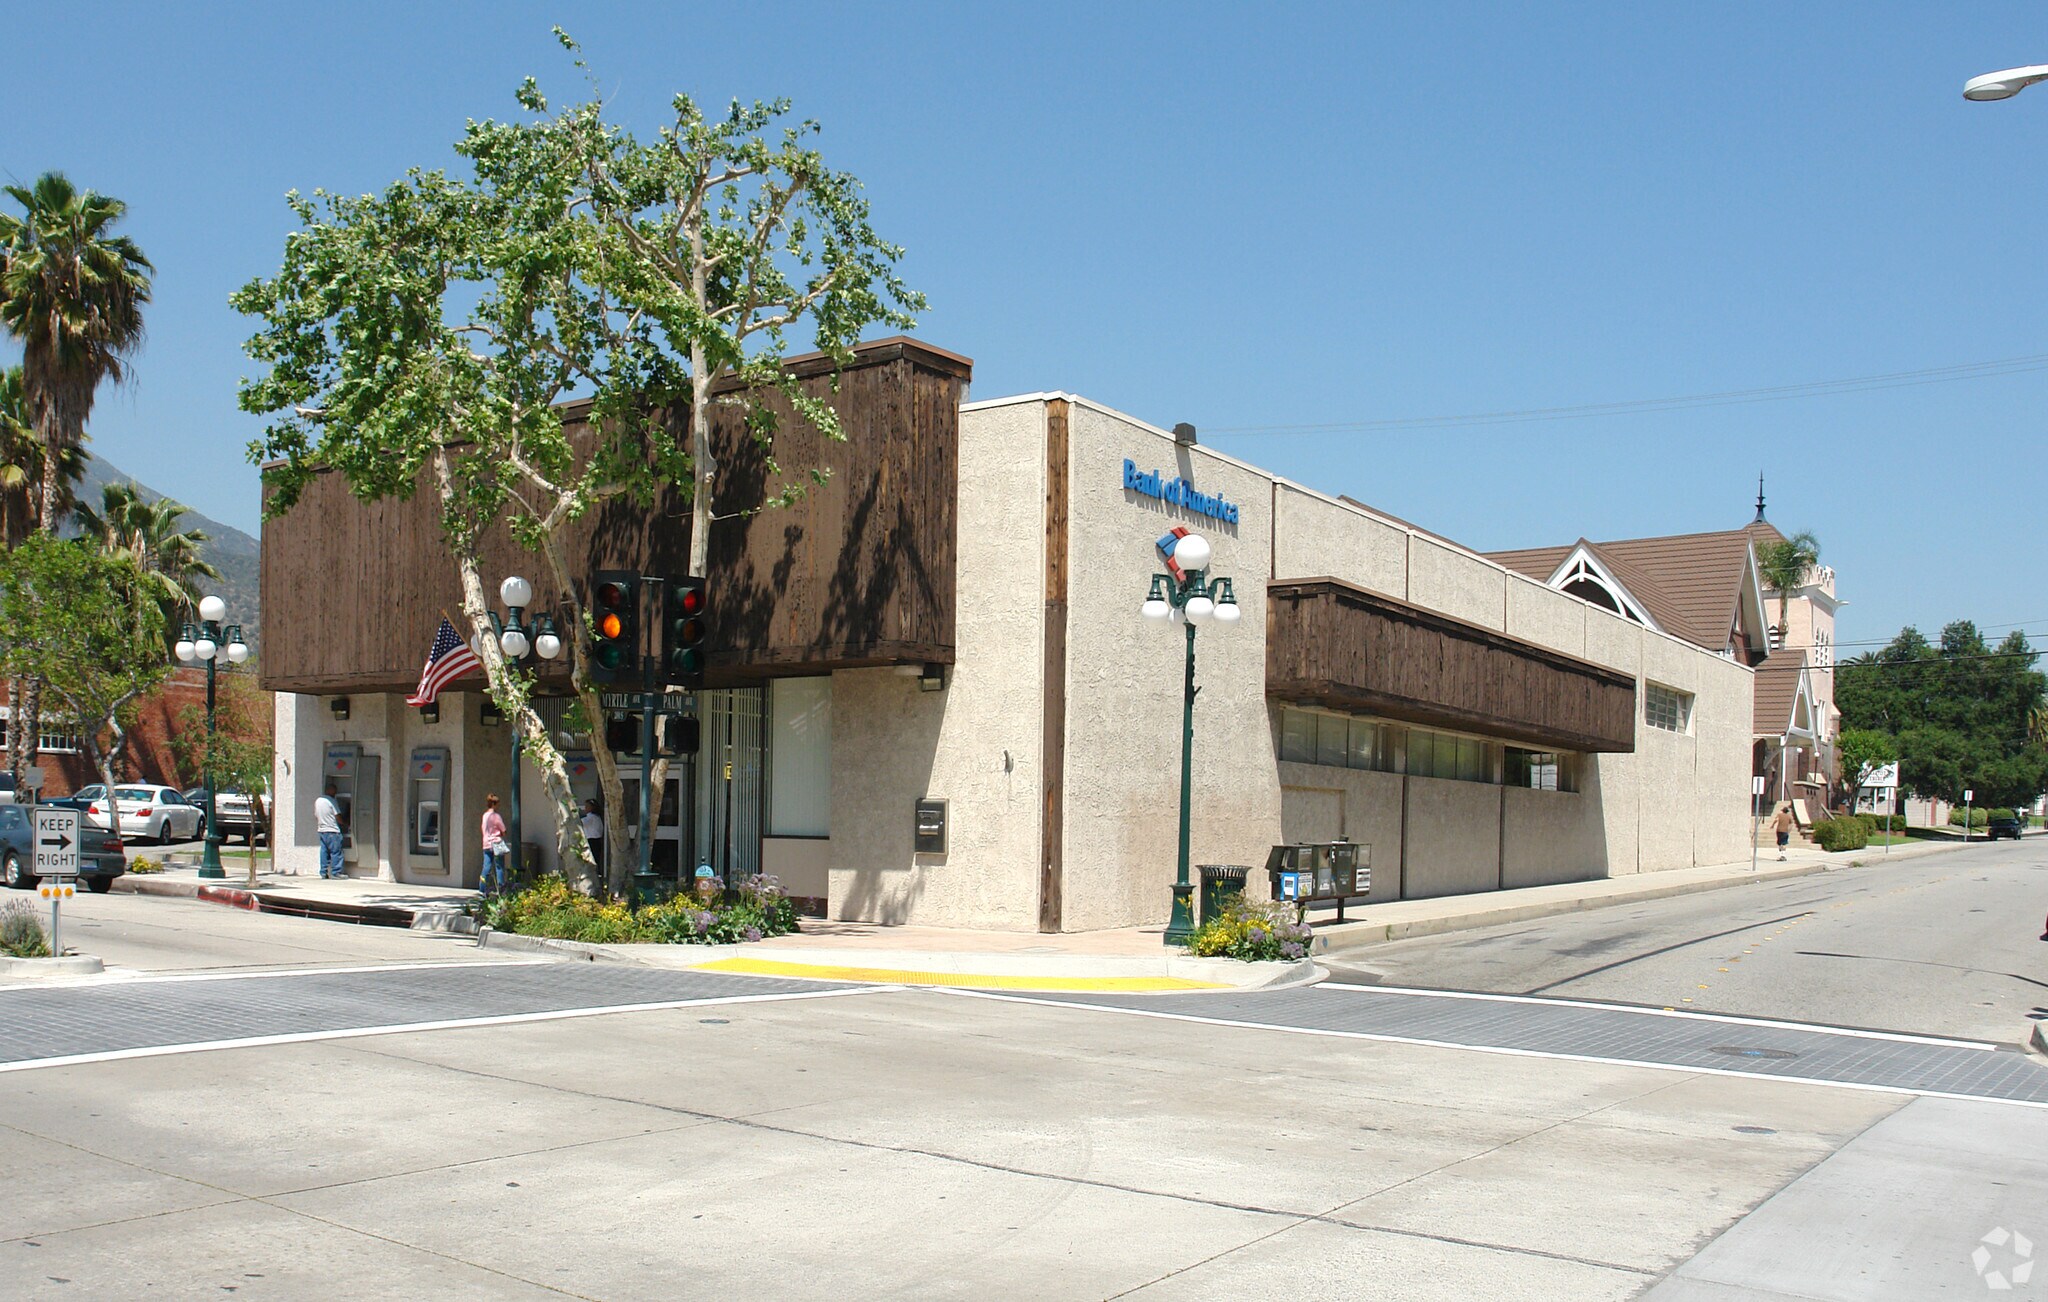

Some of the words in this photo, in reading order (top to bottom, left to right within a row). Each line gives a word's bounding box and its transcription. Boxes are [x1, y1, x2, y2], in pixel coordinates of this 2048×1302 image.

[1123, 458, 1163, 499] Bank
[1164, 477, 1182, 504] of
[1182, 481, 1238, 524] America
[602, 693, 629, 708] MYRTLE
[663, 695, 682, 710] PALM
[40, 819, 74, 831] KEEP
[37, 853, 76, 866] RIGHT
